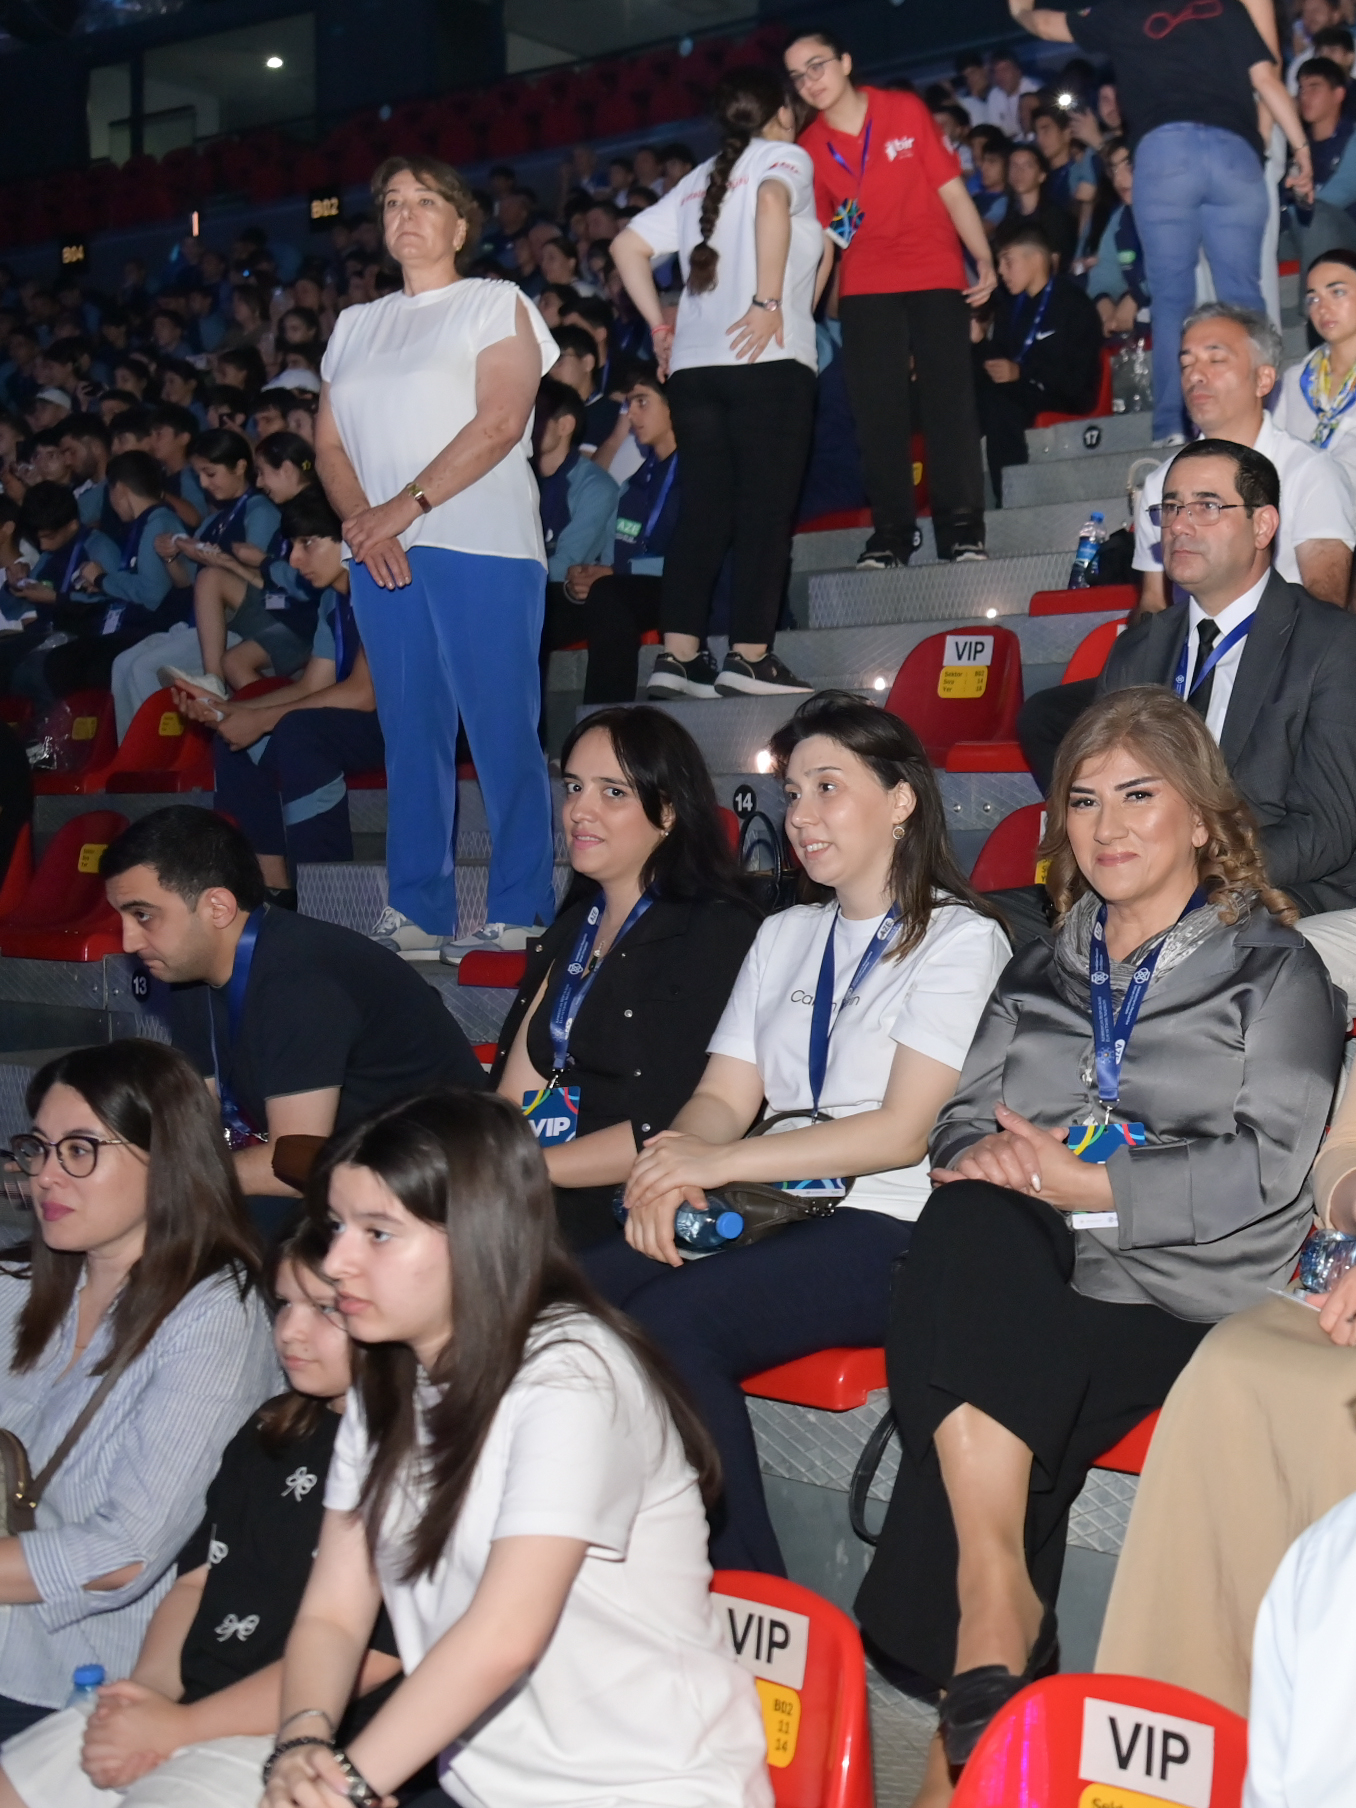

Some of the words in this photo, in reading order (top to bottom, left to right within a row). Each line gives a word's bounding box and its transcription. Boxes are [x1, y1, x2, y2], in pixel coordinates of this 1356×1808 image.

[1085, 430, 1099, 445] 17
[955, 641, 985, 661] VIP
[735, 793, 753, 812] 14
[879, 920, 892, 937] AZE
[133, 976, 147, 995] 13
[529, 1117, 571, 1138] VIP
[728, 1608, 791, 1664] VIP
[774, 1699, 794, 1715] B02
[1109, 1715, 1190, 1781] VIP
